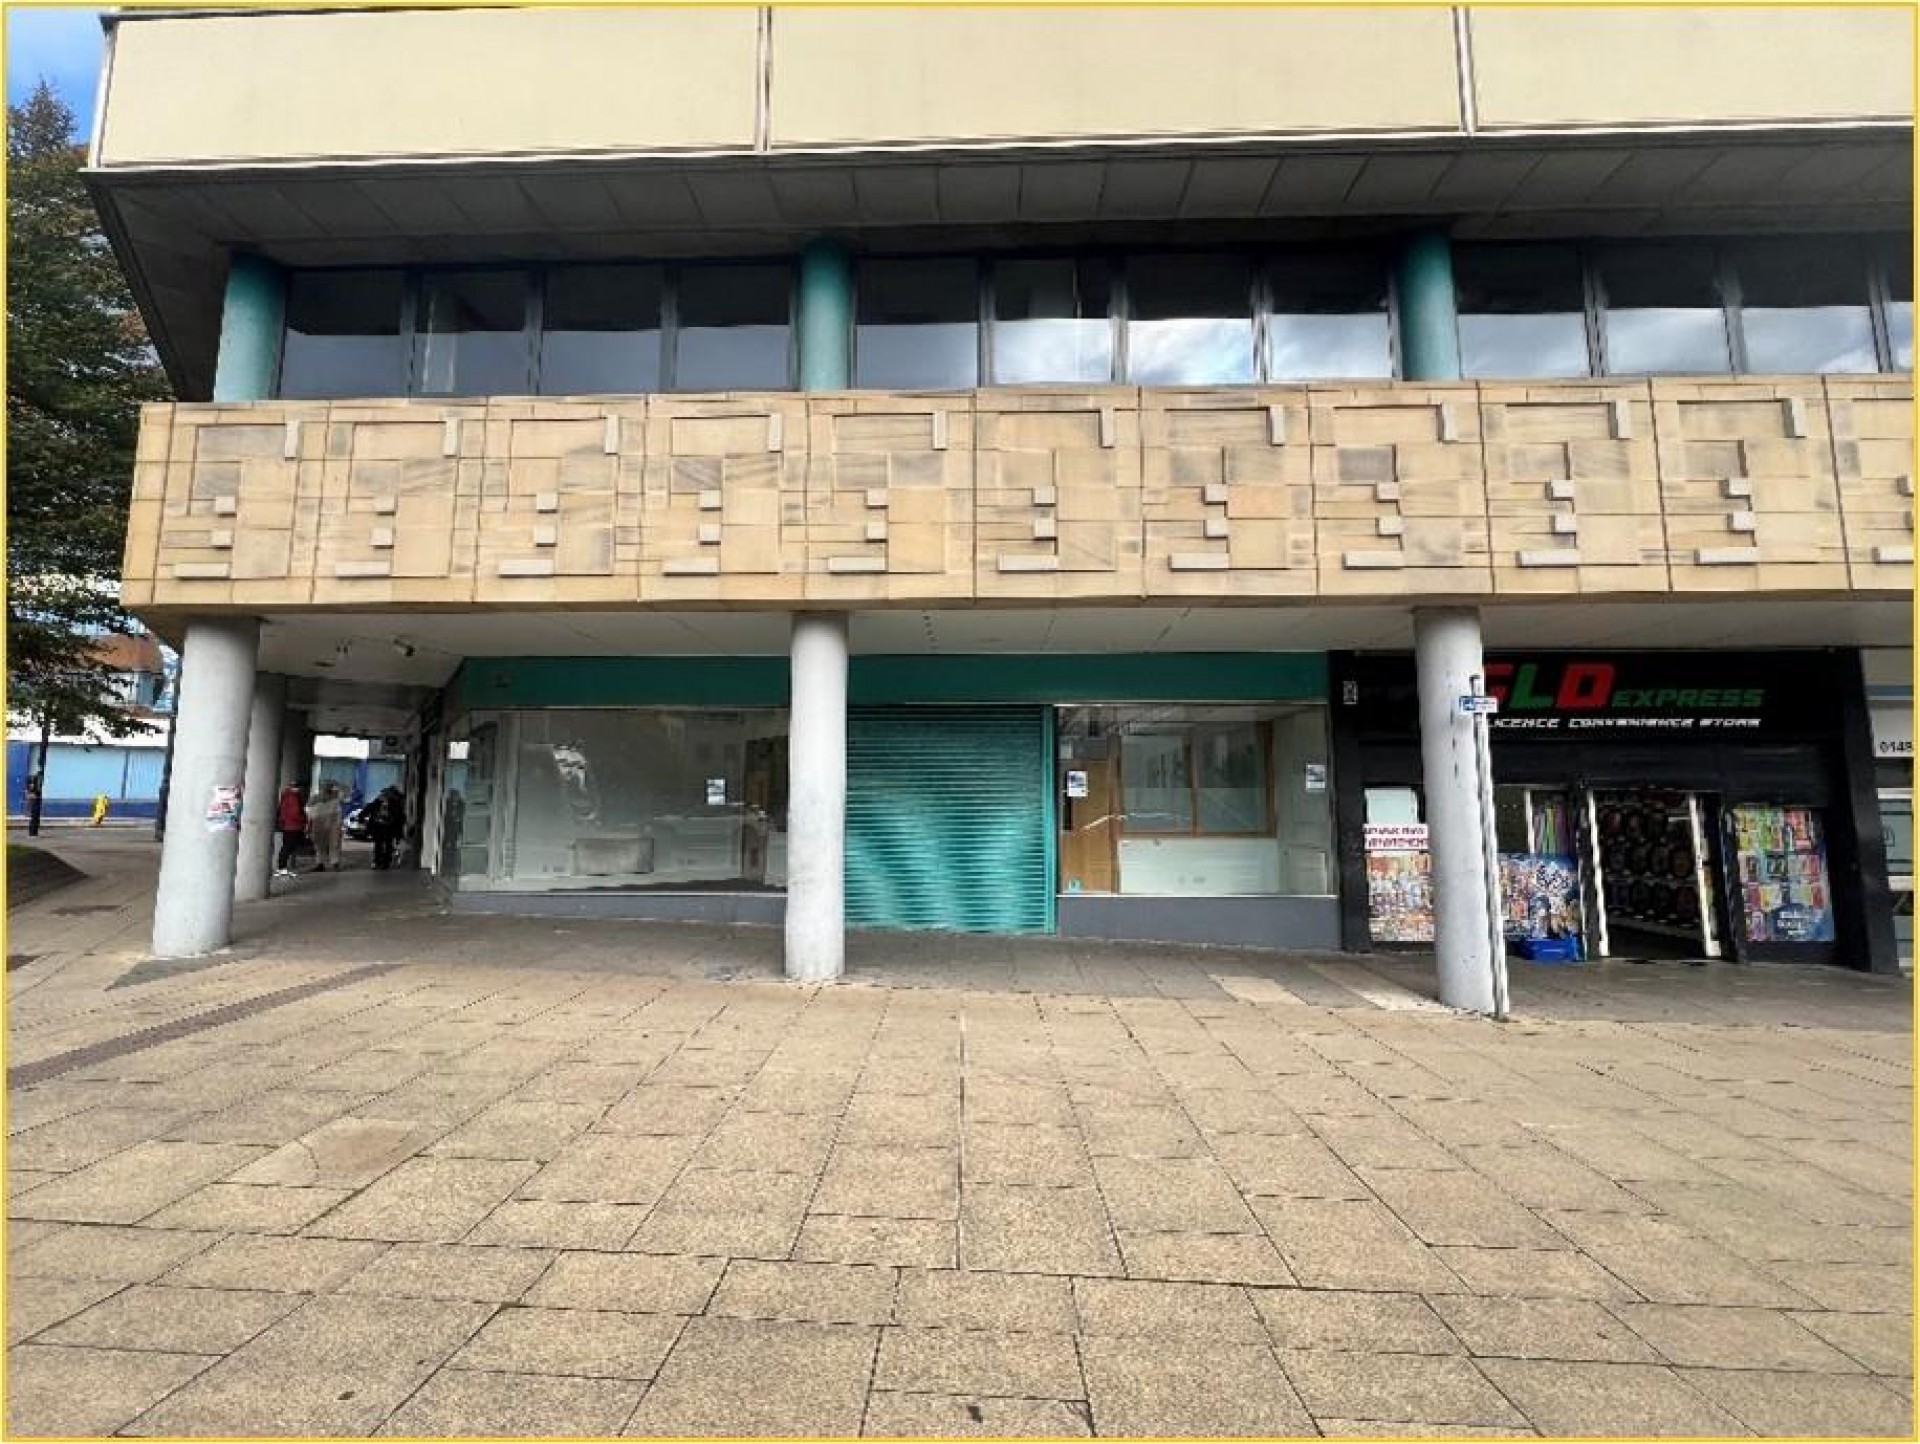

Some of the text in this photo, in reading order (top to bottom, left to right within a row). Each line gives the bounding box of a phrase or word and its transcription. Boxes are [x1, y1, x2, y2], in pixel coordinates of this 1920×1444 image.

[1611, 688, 1765, 708] EXPRESS
[1568, 718, 1695, 729] CONVENIENCE
[1699, 718, 1762, 728] STORE
